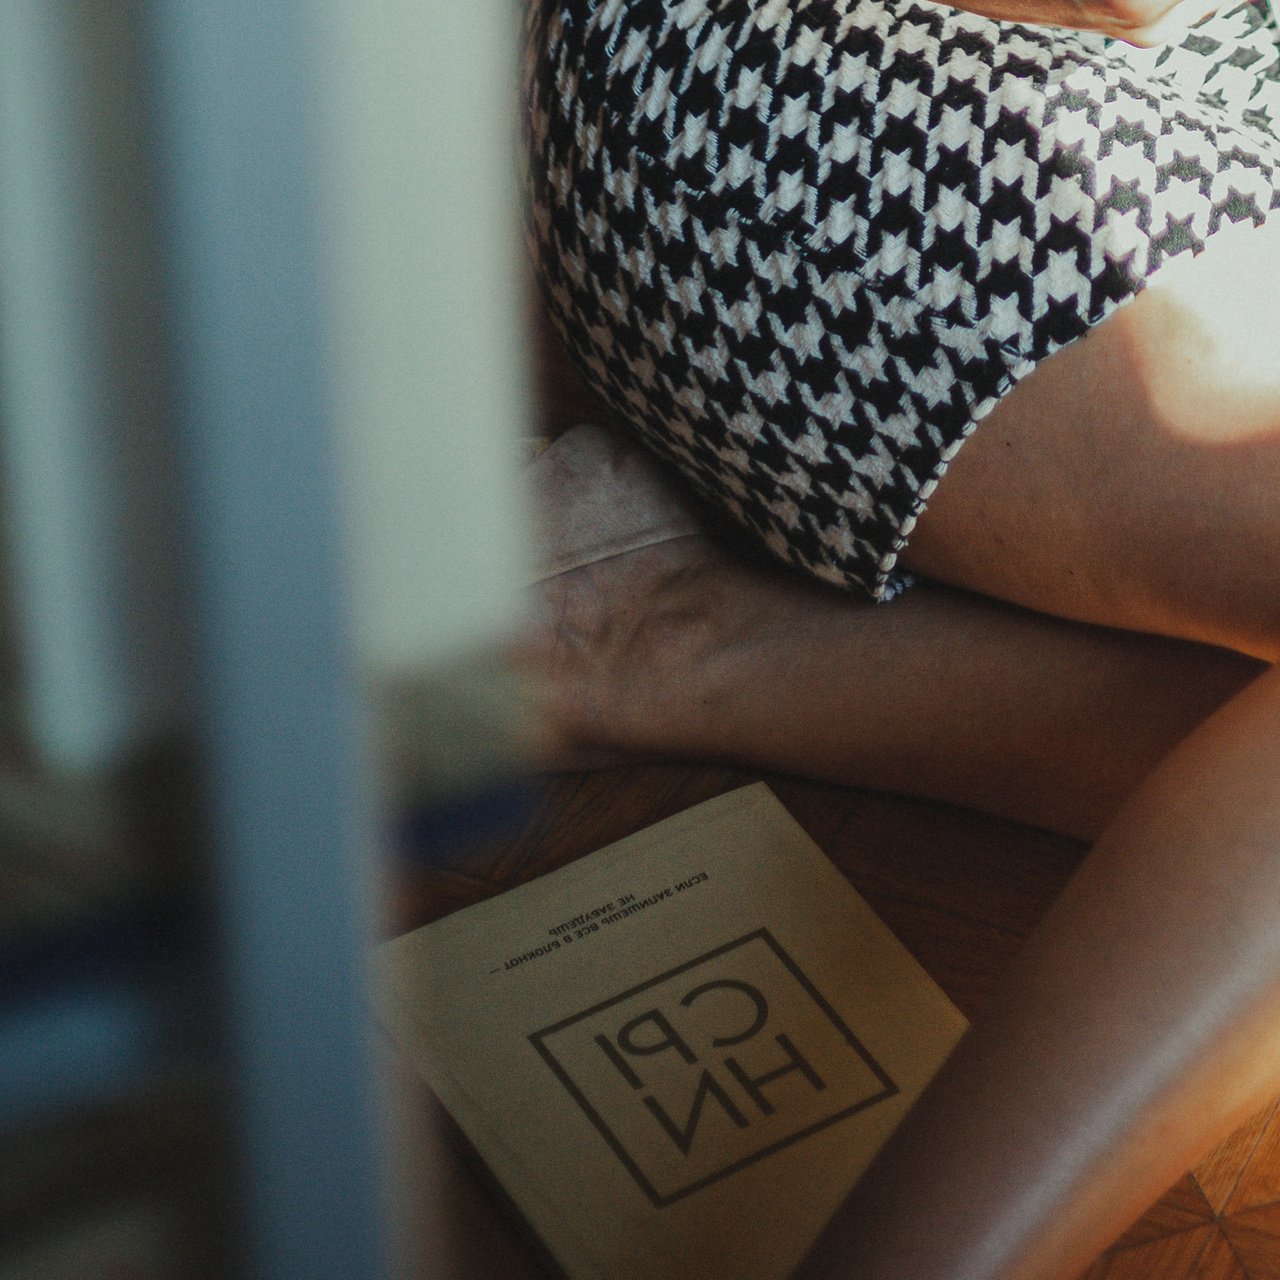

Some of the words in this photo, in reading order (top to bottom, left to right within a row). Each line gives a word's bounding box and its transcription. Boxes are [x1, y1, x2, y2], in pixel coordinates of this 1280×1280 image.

[673, 870, 708, 892] ЕСЛИ
[599, 886, 673, 927] ЗАПИШЕШЬ
[616, 892, 636, 907] НЕ
[547, 900, 616, 939] ЗАБУДЕШЬ
[573, 921, 599, 939] ВСЕ
[561, 933, 573, 944] В
[502, 939, 561, 972] БЛОКНОТ
[594, 978, 769, 1091] СЫ
[642, 1033, 828, 1158] НИ
